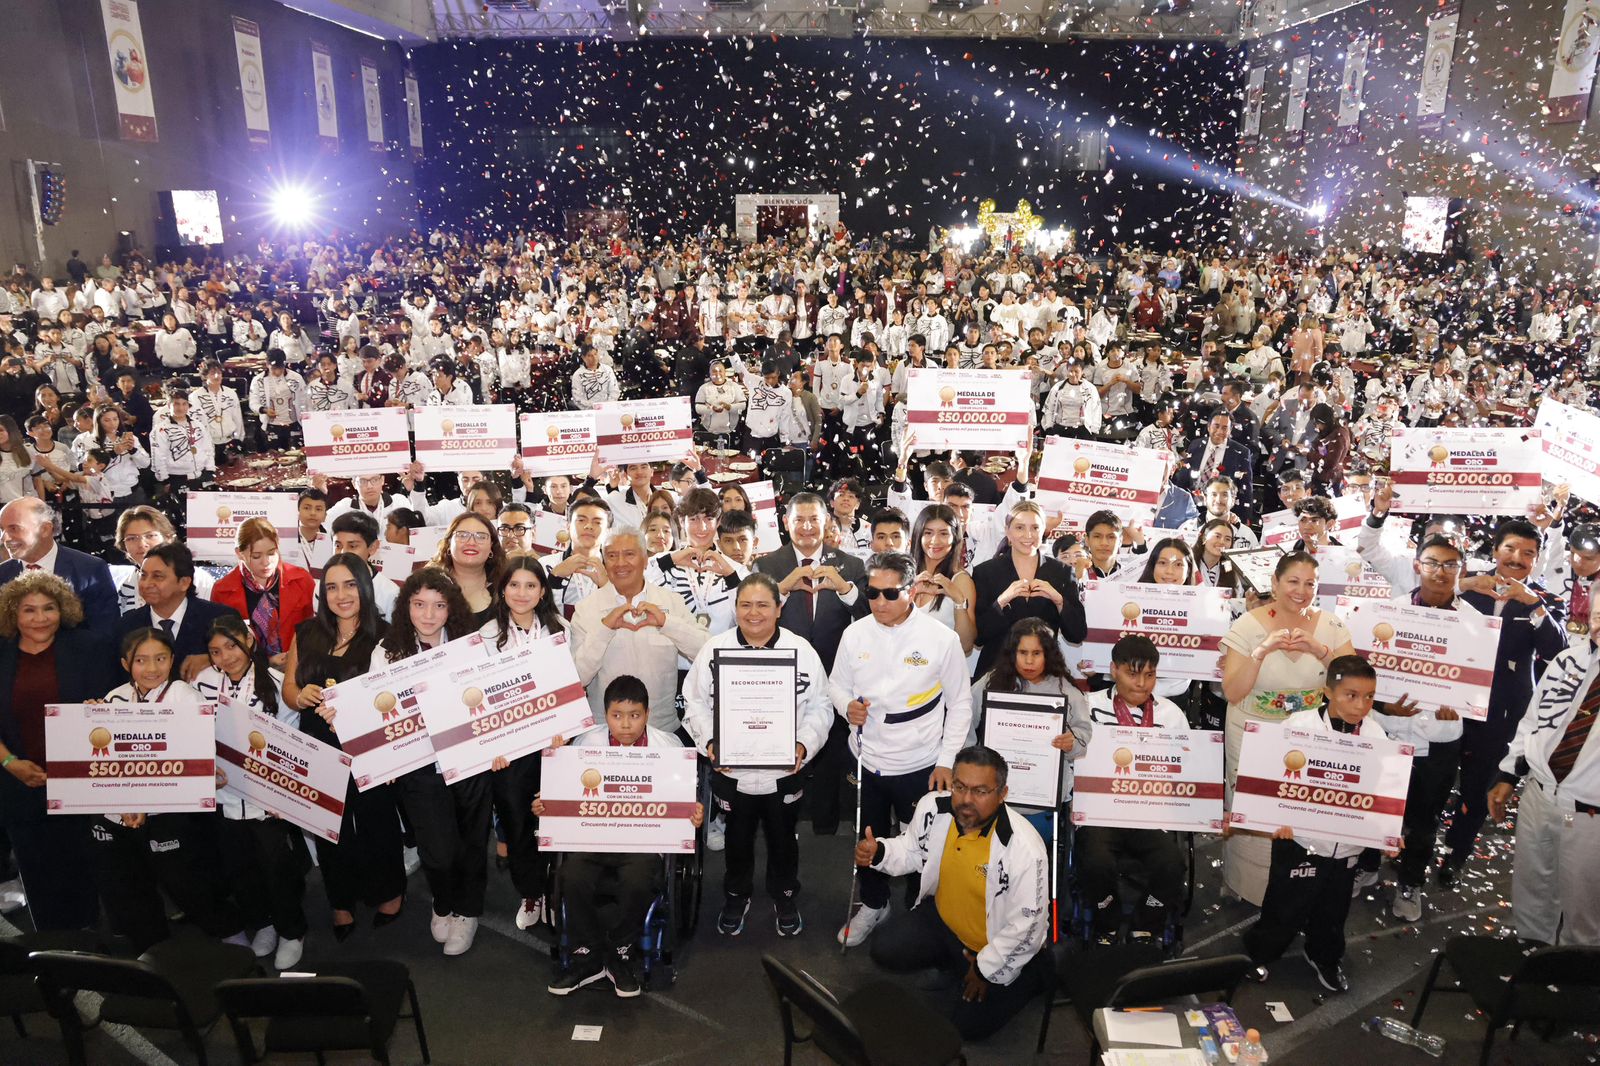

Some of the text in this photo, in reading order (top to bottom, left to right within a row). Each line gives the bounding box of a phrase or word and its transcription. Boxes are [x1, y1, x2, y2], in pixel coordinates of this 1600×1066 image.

[938, 411, 1006, 424] $50,000.00
[621, 431, 675, 443] $50,000.00
[332, 443, 390, 455] $50,000.00
[442, 439, 496, 450] $50,000.00
[1090, 464, 1120, 472] MEDALLA
[1395, 630, 1447, 645] MEDALLA DE
[1411, 642, 1431, 652] ORO
[1367, 652, 1459, 679] $50,000.00
[483, 677, 521, 696] MEDALLA
[521, 672, 533, 682] DE
[502, 686, 523, 699] ORO
[470, 693, 558, 736] $50,000.00
[997, 722, 1050, 731] RECONOCIMIENTO
[113, 733, 153, 741] MEDALLA
[131, 743, 151, 751] ORO
[267, 743, 309, 768] MEDALLA DE
[90, 761, 183, 777] $50,000.00
[279, 758, 296, 771] ORO
[1307, 759, 1362, 773] MEDALLA DE
[245, 757, 318, 802] $50,000.00
[1323, 771, 1345, 781] ORO
[1113, 778, 1195, 795] $50,000.00
[1278, 782, 1373, 809] $50,000.00
[580, 801, 666, 817] $50,000.00
[1277, 802, 1307, 812] Cincuenta
[1316, 809, 1333, 817] pesos
[1290, 867, 1316, 879] PUE
